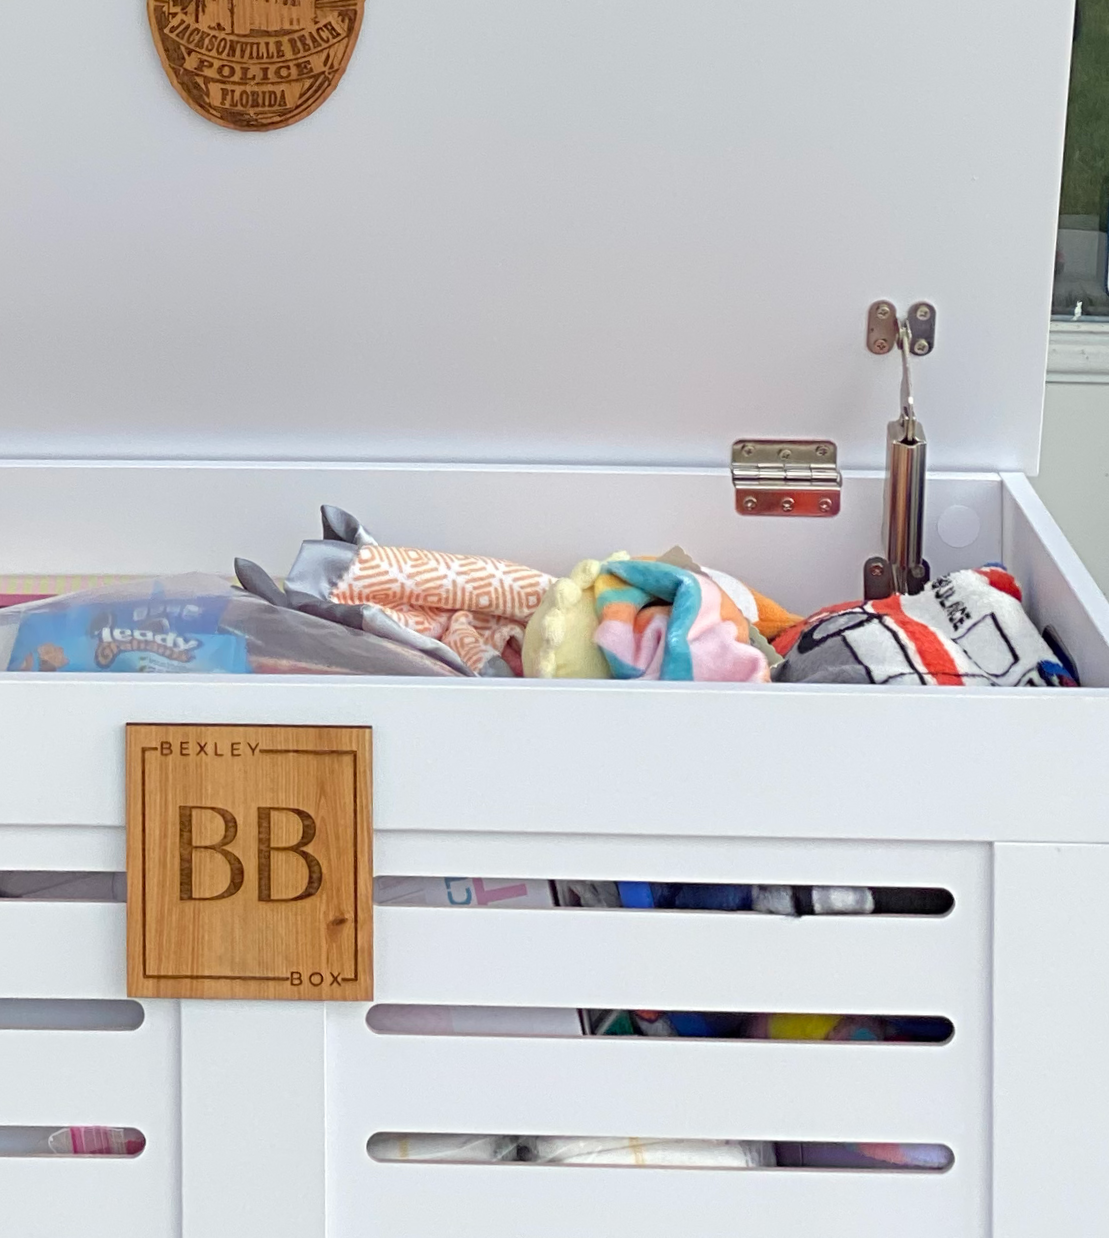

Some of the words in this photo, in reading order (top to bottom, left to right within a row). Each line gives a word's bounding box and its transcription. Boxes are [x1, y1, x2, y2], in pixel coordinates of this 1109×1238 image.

[169, 19, 285, 60] JACKSONVILLE
[288, 23, 341, 54] BEACH
[194, 59, 313, 80] POLICE
[220, 87, 287, 108] FLORIDA
[160, 741, 260, 756] BEXLEY
[178, 805, 323, 902] BB
[290, 971, 342, 986] BOX
